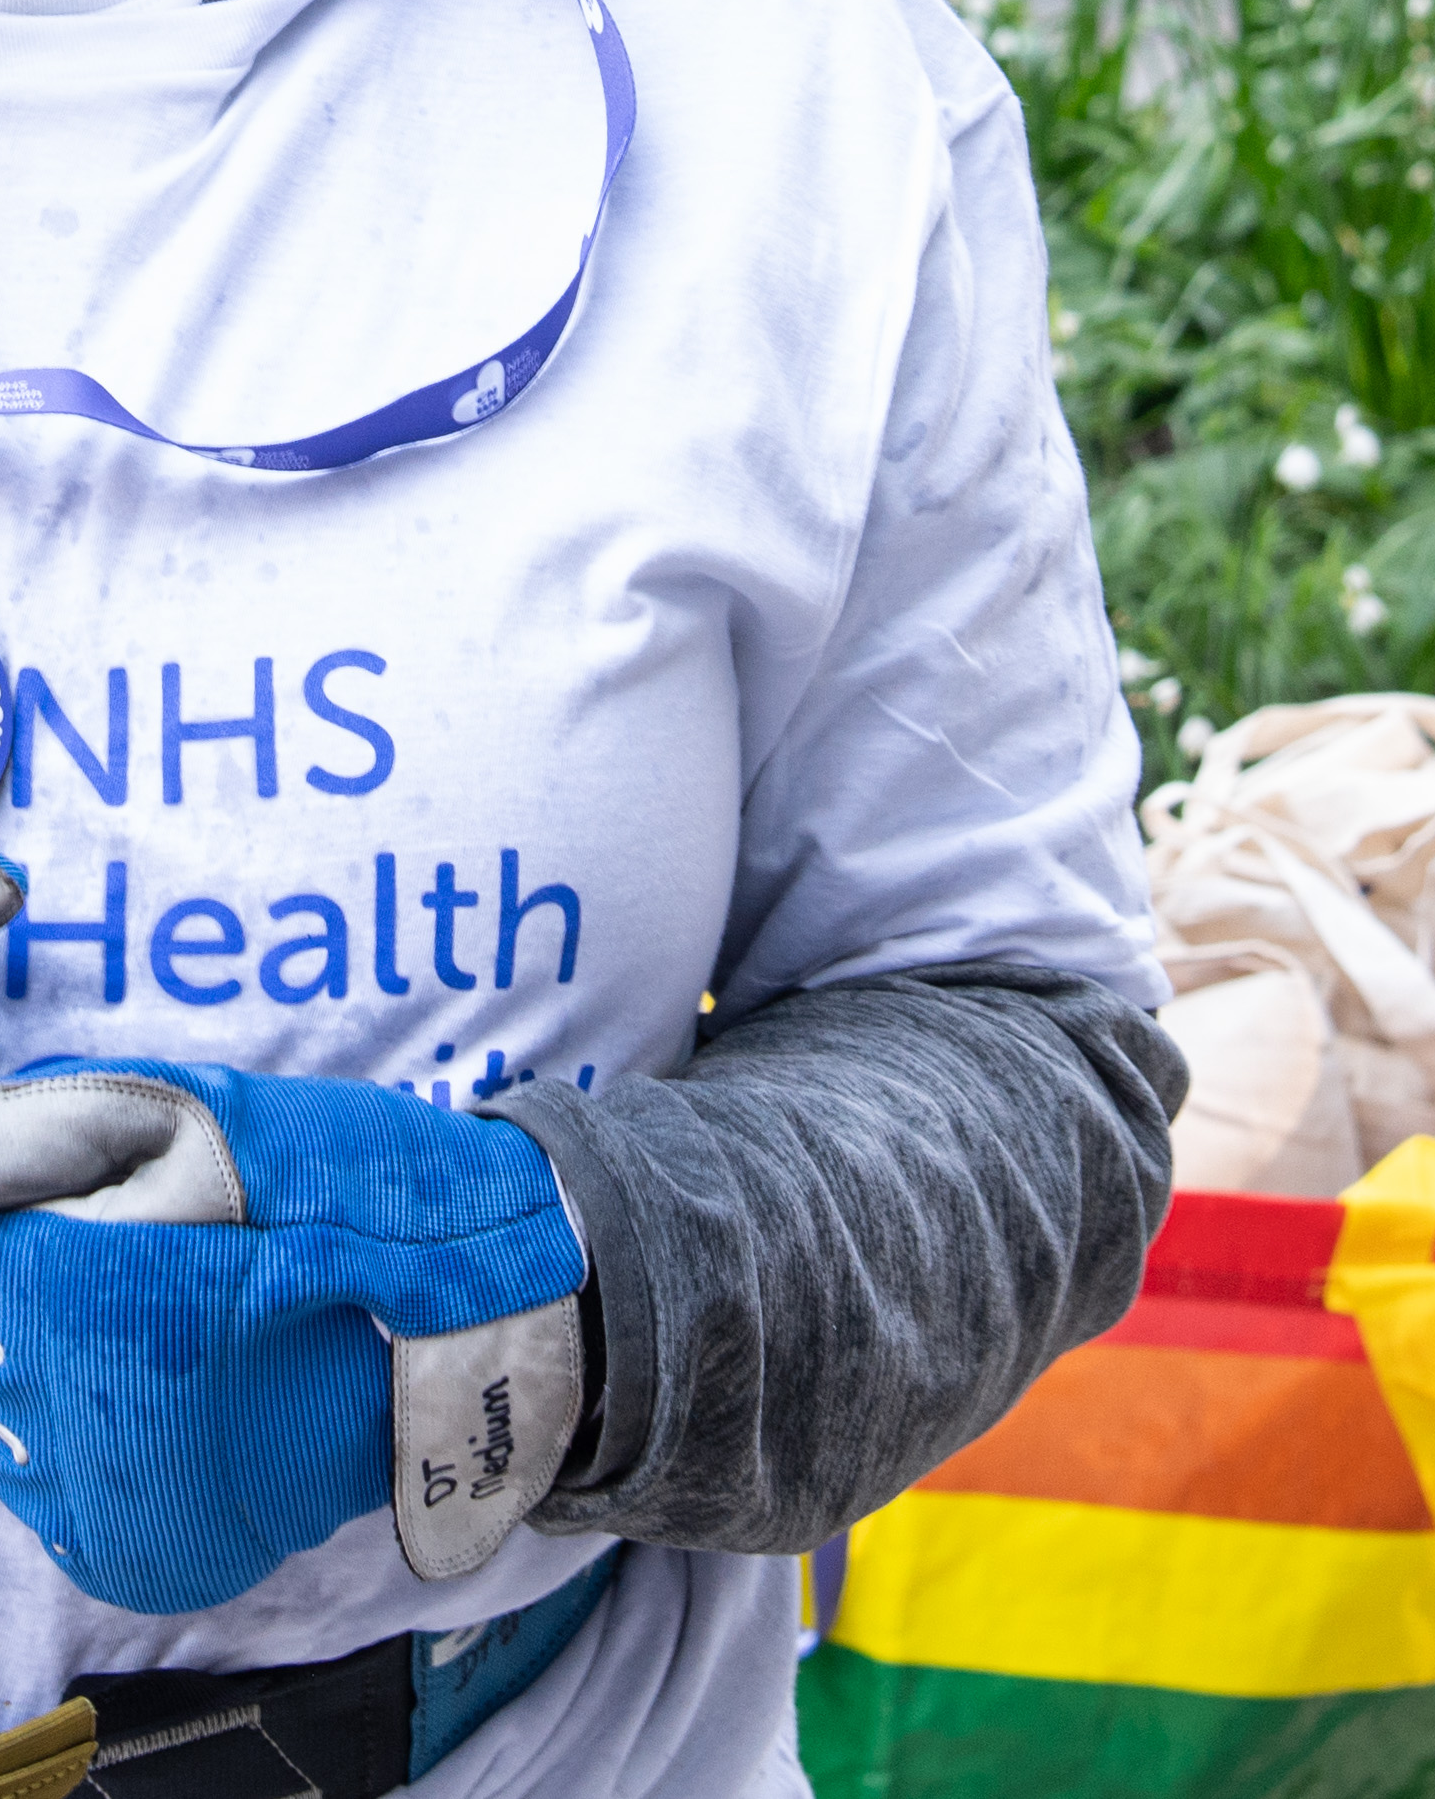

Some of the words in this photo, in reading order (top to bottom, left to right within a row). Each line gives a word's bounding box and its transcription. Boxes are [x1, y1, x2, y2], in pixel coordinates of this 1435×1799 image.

[11, 648, 397, 808] NHS
[5, 847, 583, 1007] Health
[421, 1457, 457, 1509] DT
[469, 1375, 514, 1501] Medium
